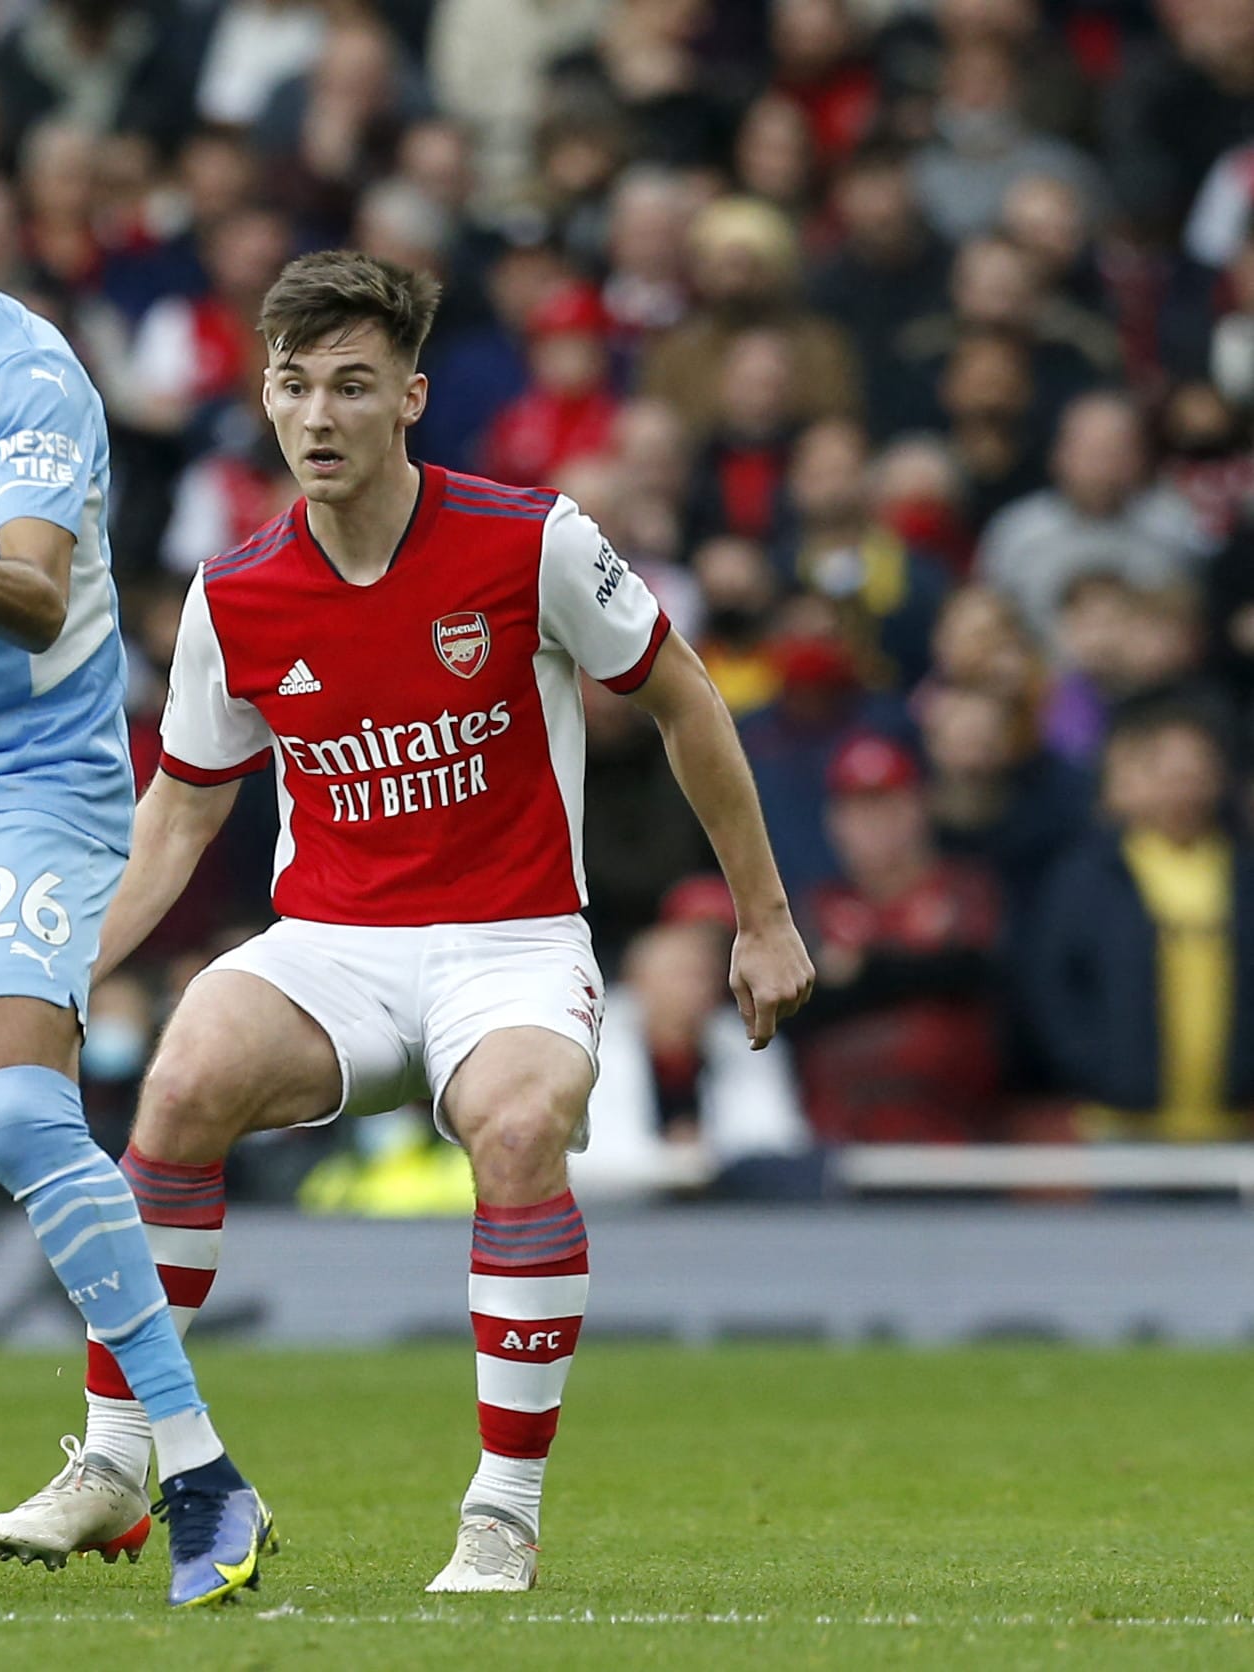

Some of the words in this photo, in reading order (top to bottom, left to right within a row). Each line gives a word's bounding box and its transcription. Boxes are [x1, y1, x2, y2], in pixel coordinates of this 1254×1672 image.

[9, 455, 74, 482] TIRE
[440, 620, 481, 638] Arsenal
[278, 679, 322, 696] adidas
[278, 701, 512, 776] Emirates
[329, 780, 371, 823] FLY
[380, 753, 489, 818] BETTER
[499, 1330, 562, 1351] AFC
